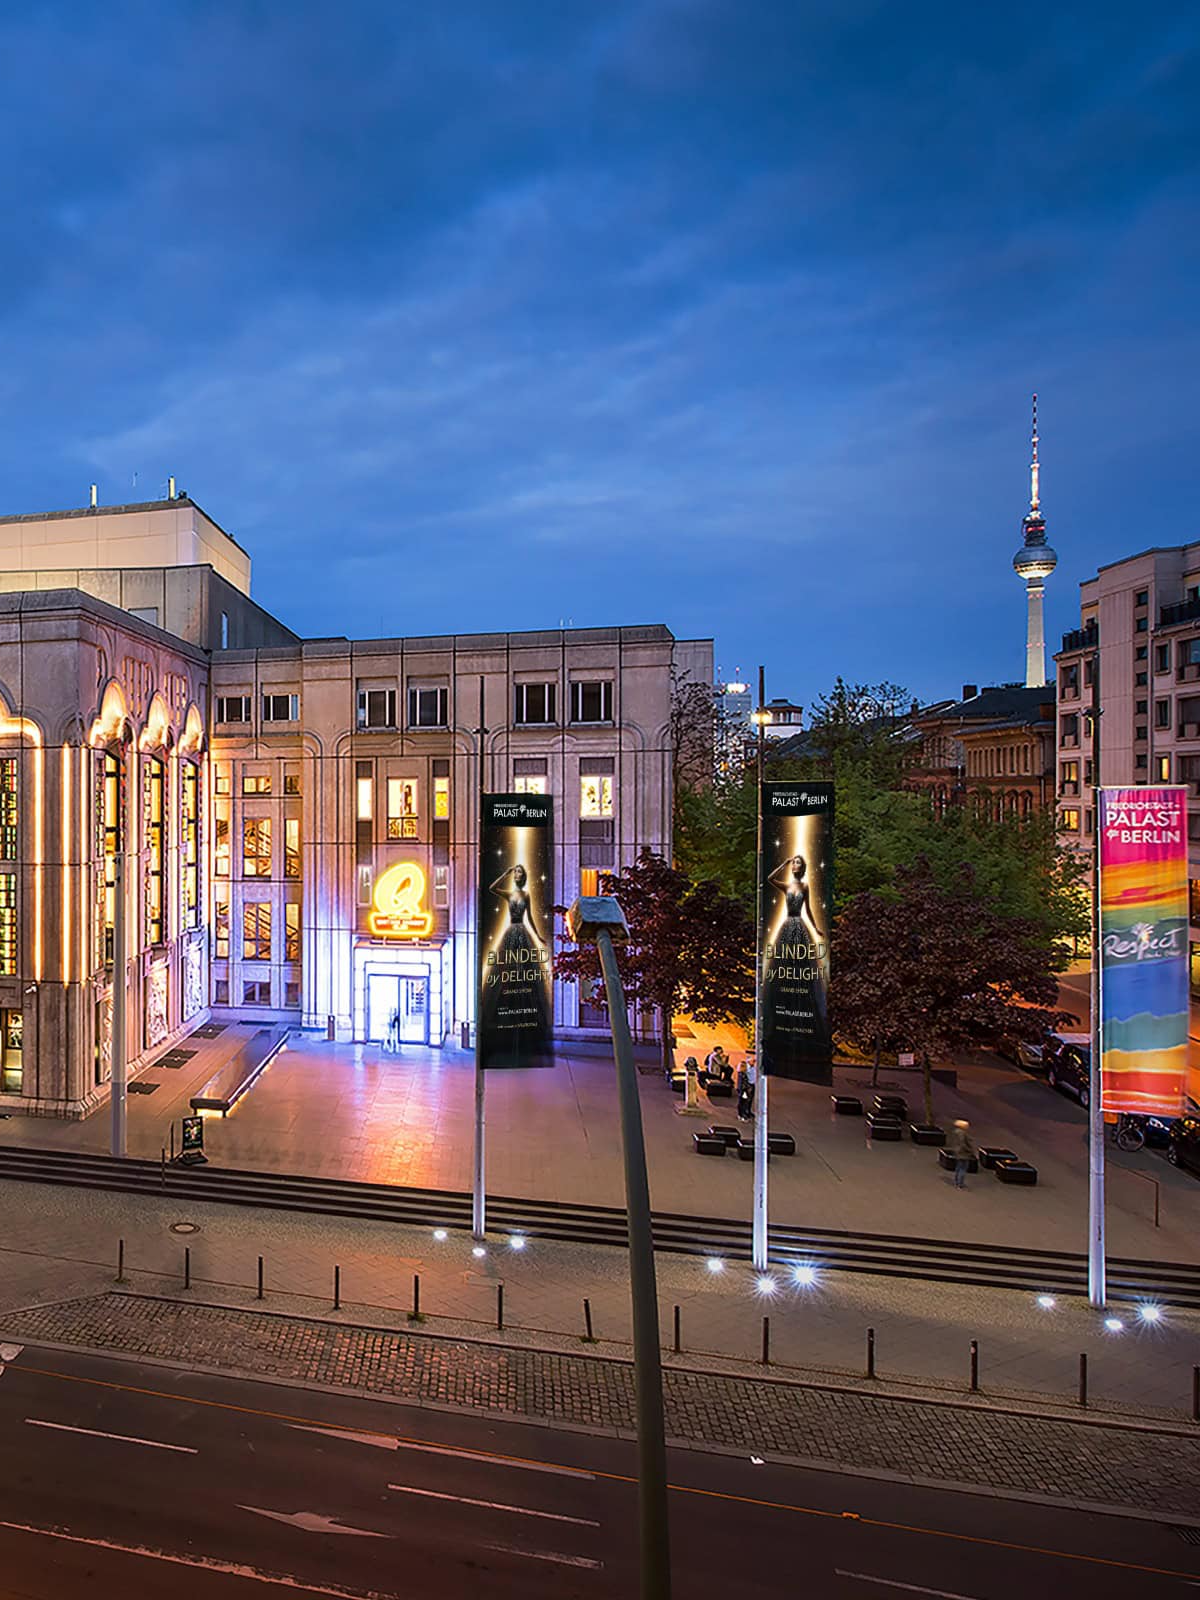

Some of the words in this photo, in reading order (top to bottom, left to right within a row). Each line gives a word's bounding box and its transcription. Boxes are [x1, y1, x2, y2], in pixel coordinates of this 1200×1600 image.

[772, 797, 799, 807] PALAST
[806, 795, 828, 806] BERLIN
[493, 808, 520, 818] PALAST
[526, 808, 547, 818] BERLIN
[1106, 811, 1181, 827] PALAST
[1121, 830, 1181, 843] BERLIN
[487, 948, 550, 966] BLINDED
[765, 943, 828, 960] BLINDED
[501, 969, 550, 983] DELIGHT
[778, 966, 826, 981] DELIGHT
